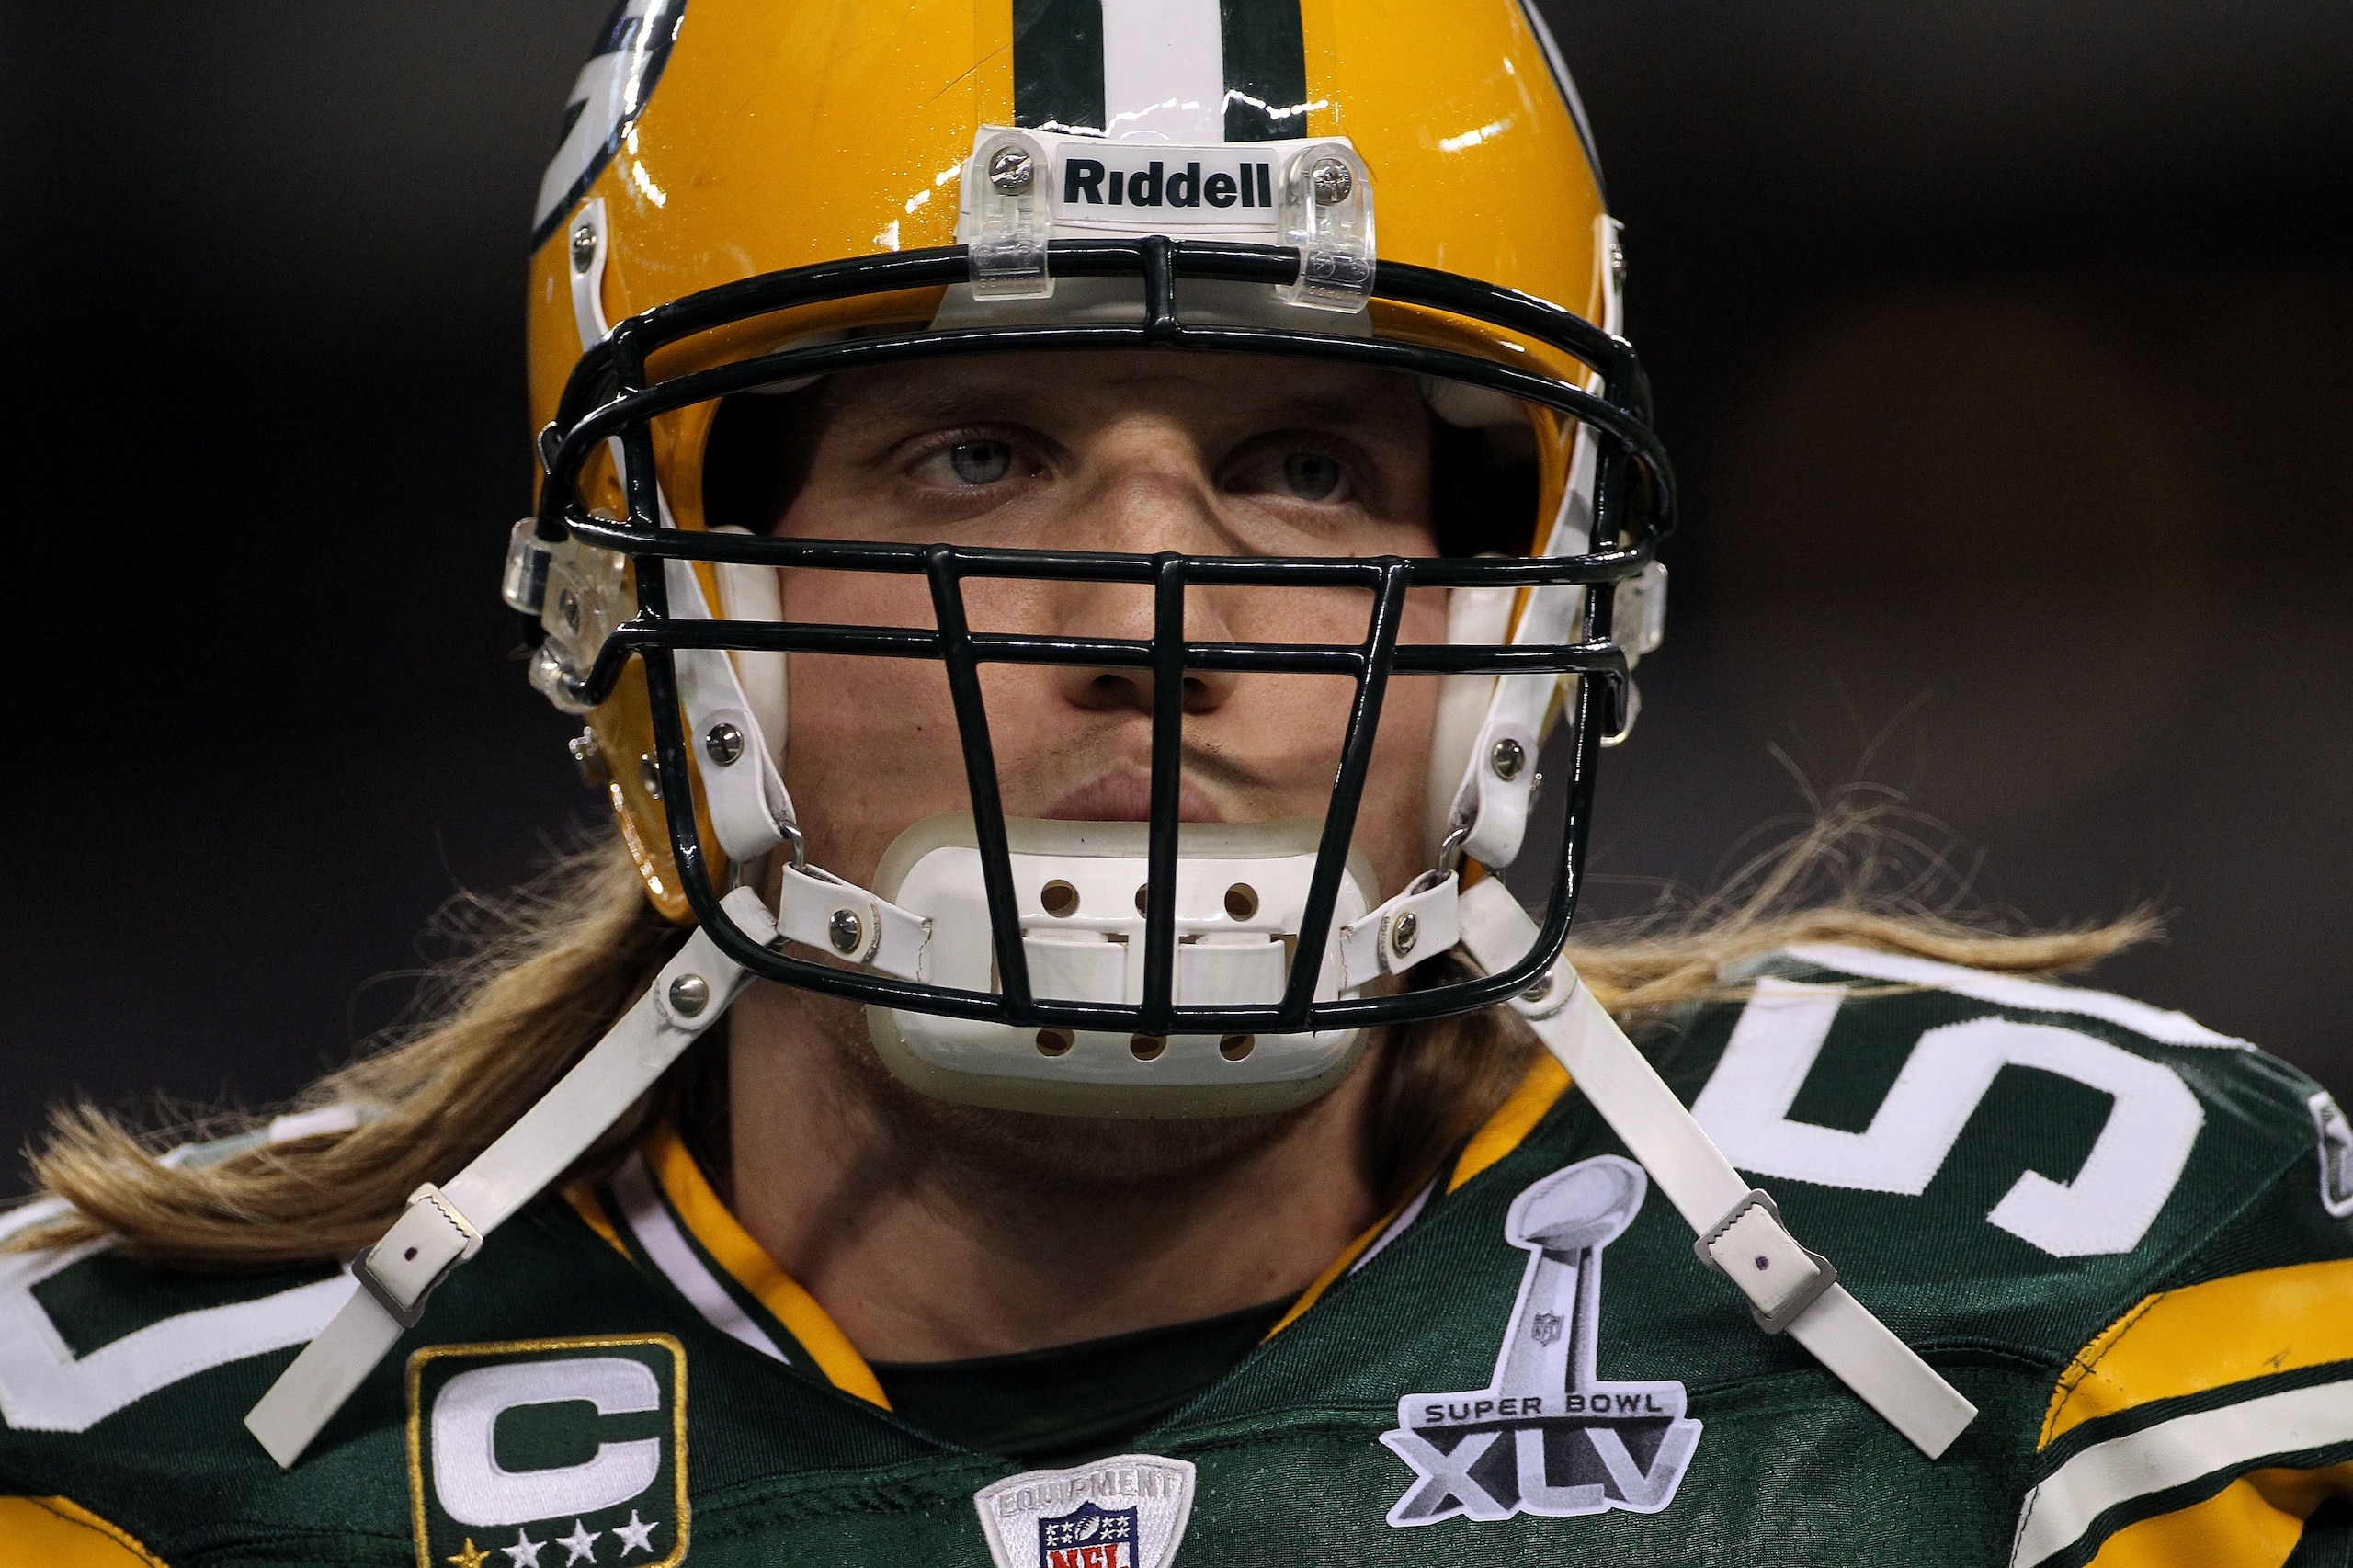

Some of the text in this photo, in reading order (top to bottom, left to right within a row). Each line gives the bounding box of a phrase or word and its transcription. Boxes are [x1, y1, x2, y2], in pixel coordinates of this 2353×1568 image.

[1063, 158, 1272, 208] Riddell
[1689, 947, 2252, 1258] 5
[1425, 1393, 1663, 1423] SUPER BOWL
[432, 1358, 660, 1527] C
[999, 1470, 1177, 1517] EQUIPMENT
[1390, 1425, 1696, 1520] XLV
[1050, 1544, 1130, 1568] NFL
